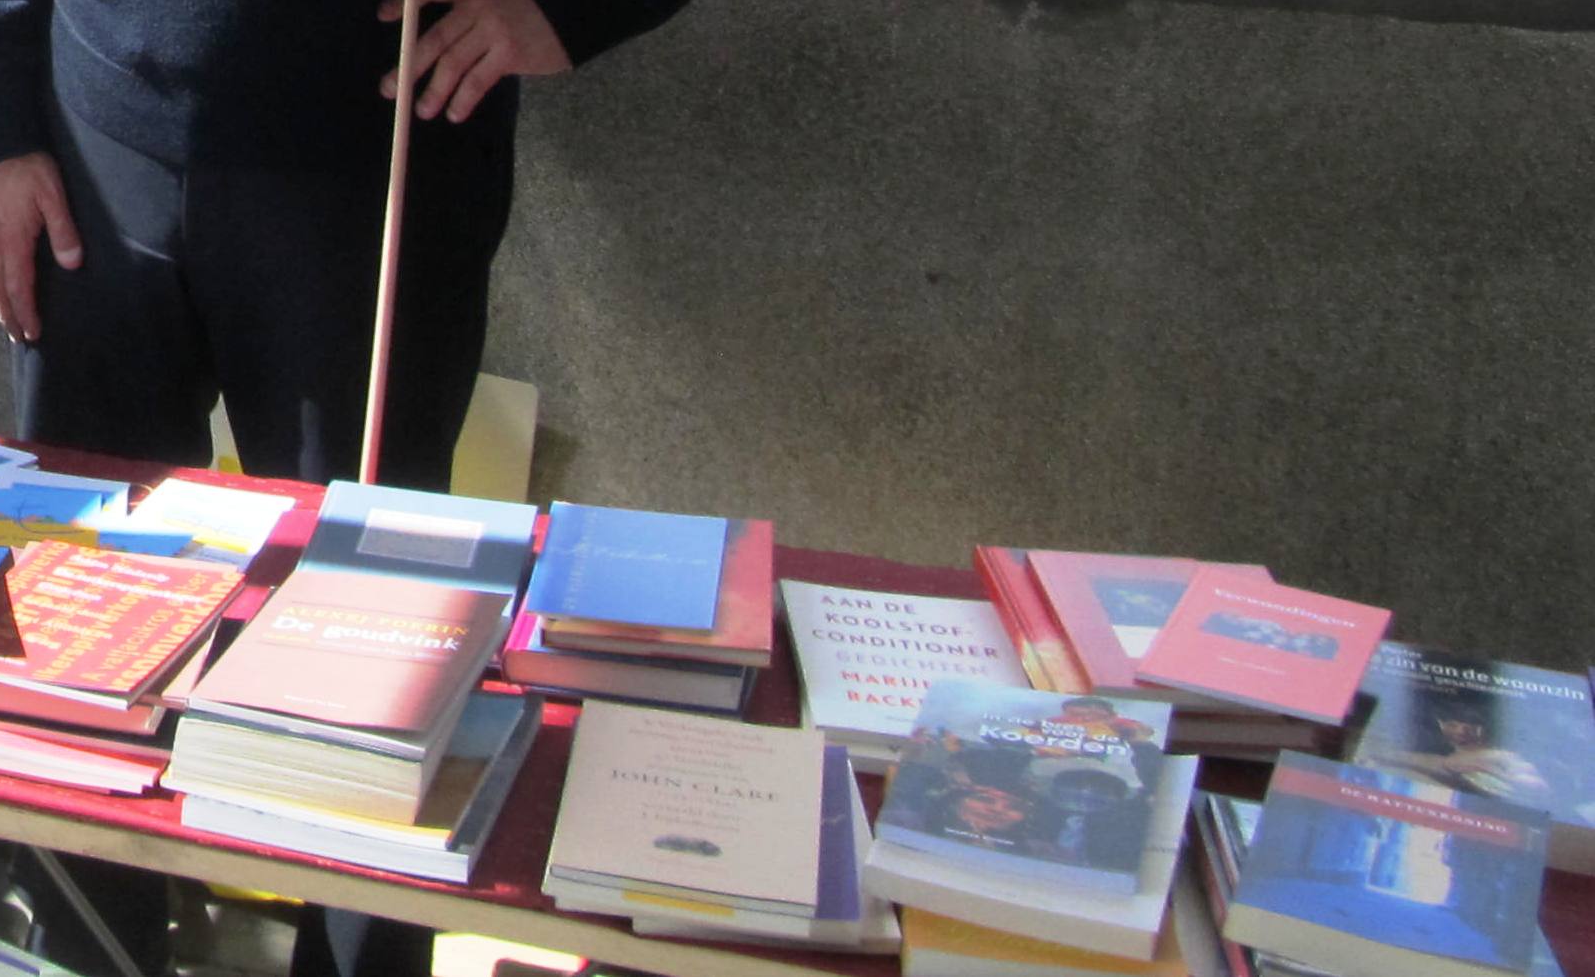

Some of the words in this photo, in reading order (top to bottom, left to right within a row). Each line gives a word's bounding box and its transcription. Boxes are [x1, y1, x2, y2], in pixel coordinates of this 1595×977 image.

[820, 594, 873, 610] AAN
[883, 601, 917, 615] DE
[271, 615, 314, 632] De
[322, 624, 461, 651] goudvink
[825, 612, 974, 638] KOOLSTOF-
[812, 628, 999, 659] CONDITIONER
[1421, 660, 1458, 678] van
[1462, 667, 1490, 683] de
[1492, 674, 1586, 702] waanzin
[978, 724, 1128, 757] Koerden
[611, 769, 683, 788] JOHN
[691, 782, 780, 802] CLARE
